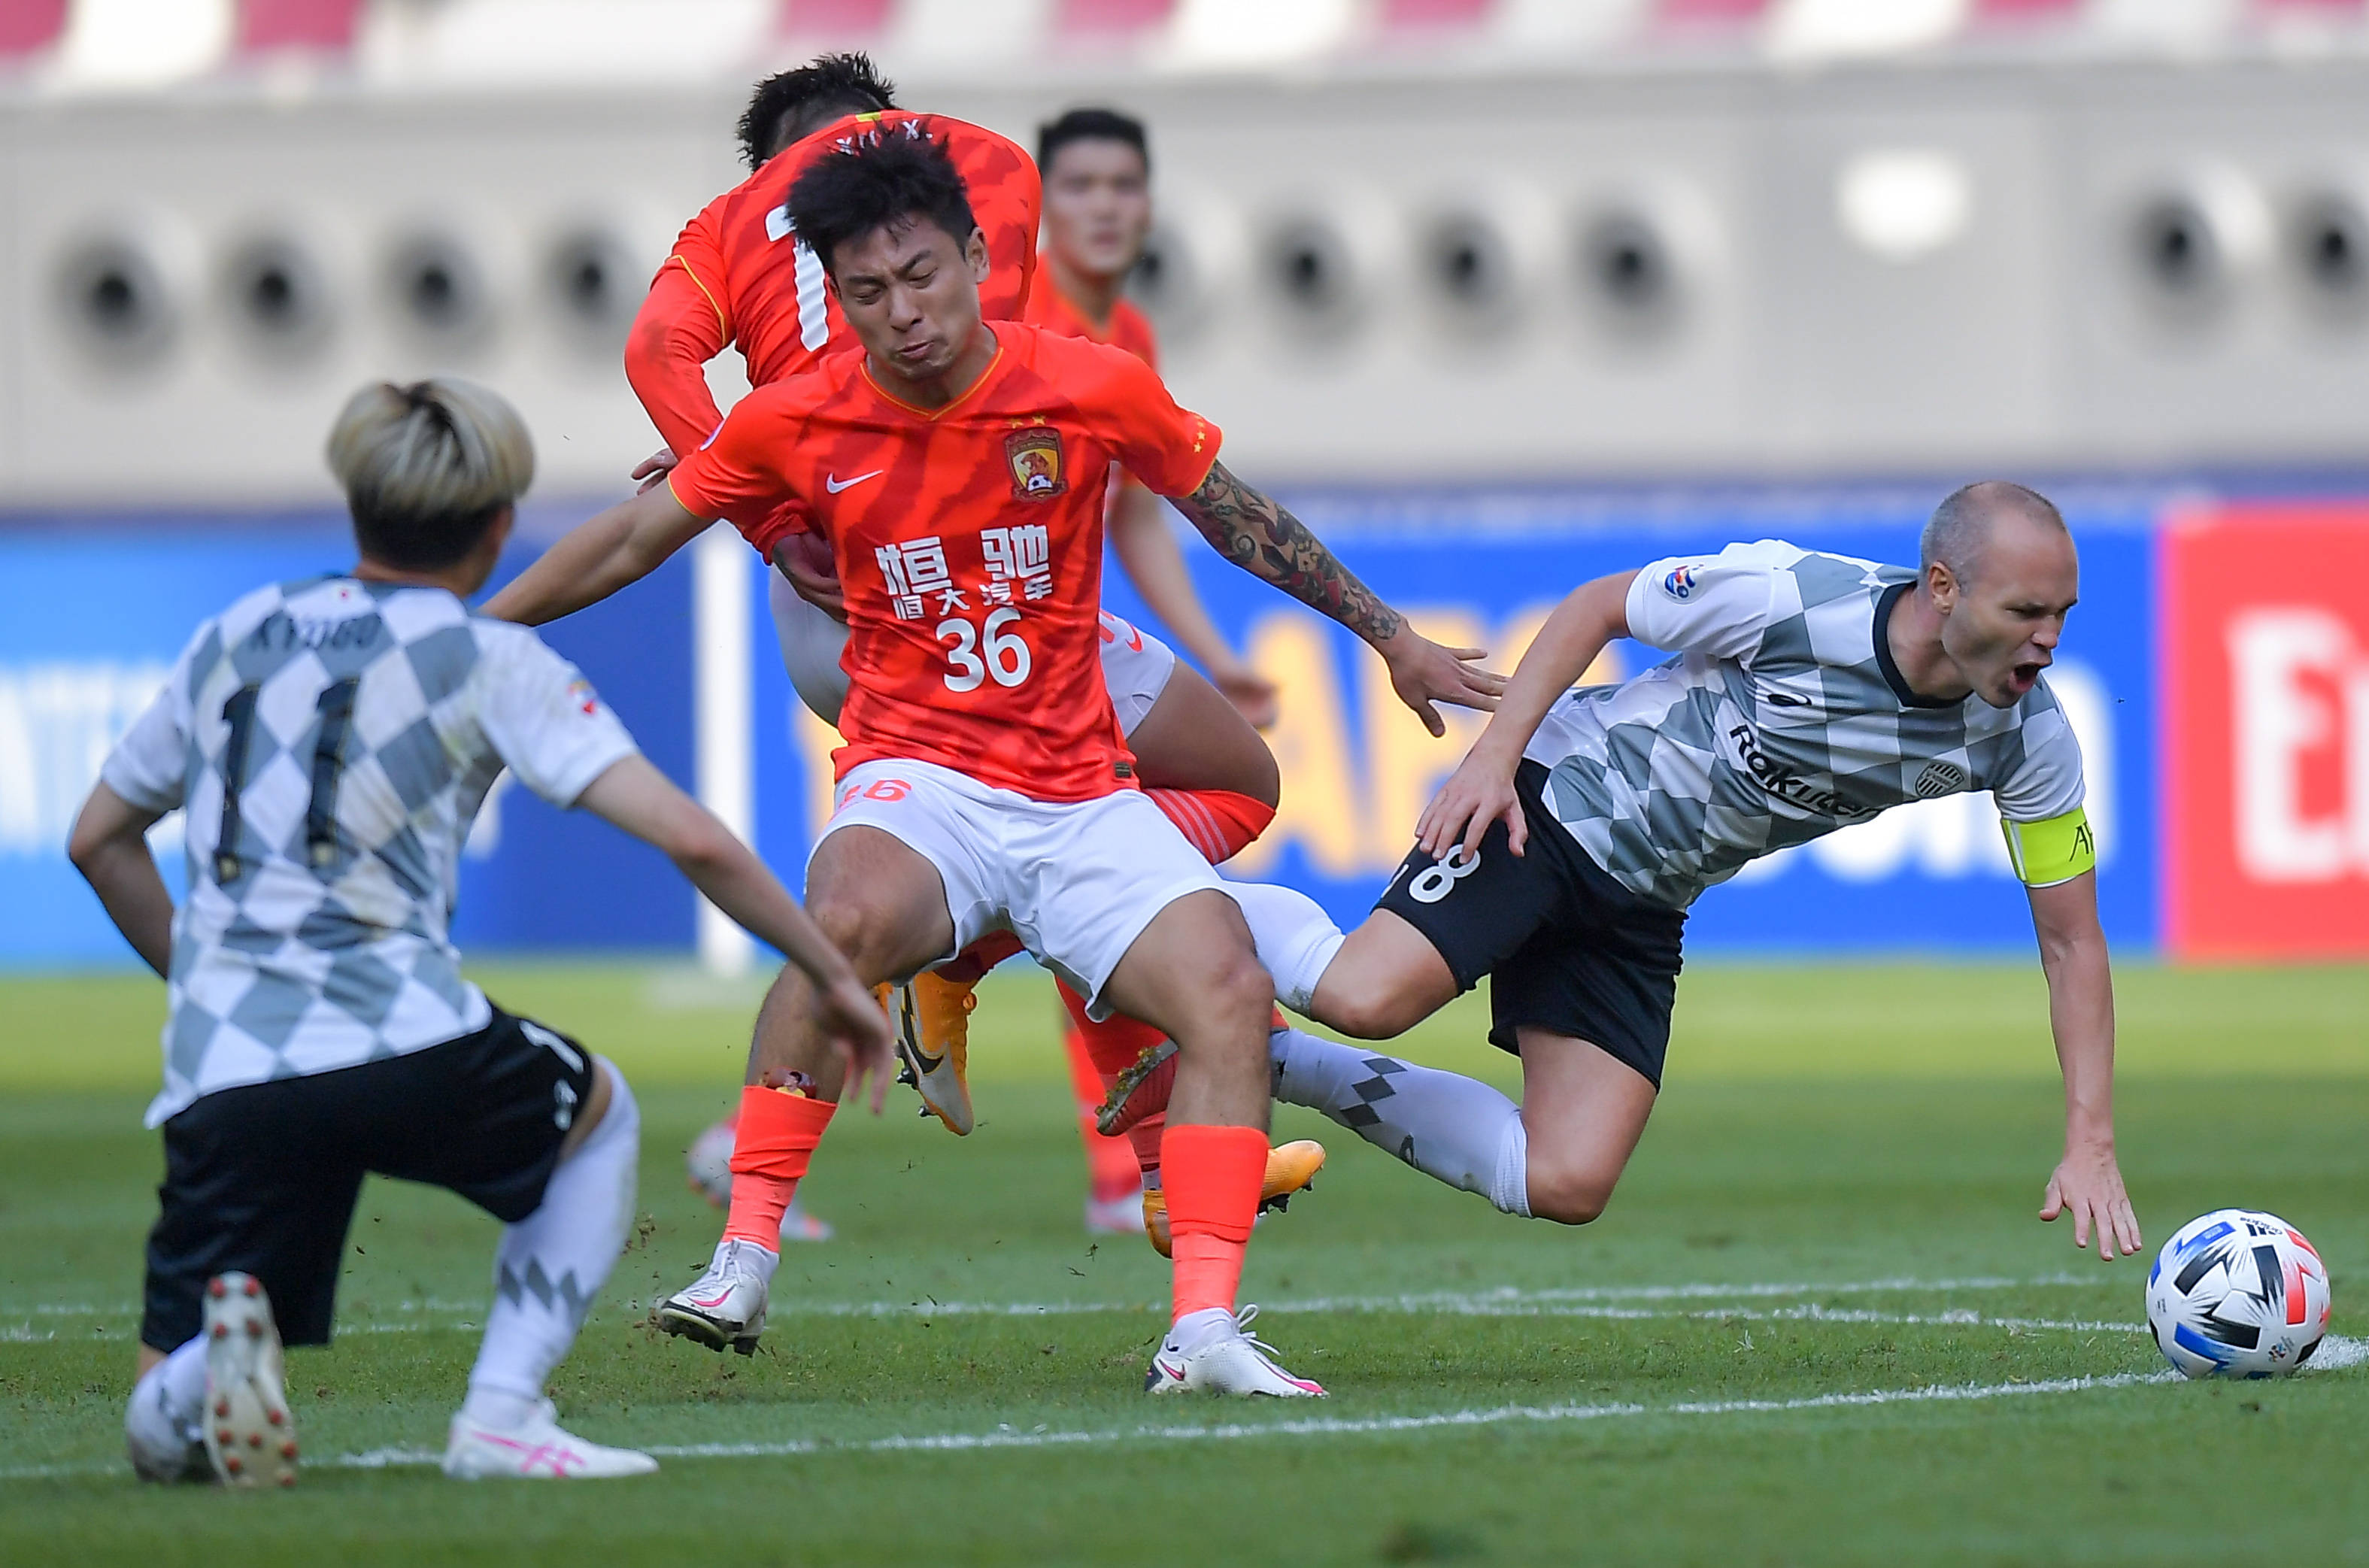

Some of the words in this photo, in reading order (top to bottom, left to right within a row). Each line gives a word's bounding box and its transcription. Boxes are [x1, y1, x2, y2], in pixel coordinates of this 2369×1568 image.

[874, 524, 1051, 596] 恒驰
[891, 573, 1053, 621] 恒大汽车
[935, 606, 1032, 693] 36
[216, 675, 362, 884] 11
[1409, 843, 1482, 903] 8
